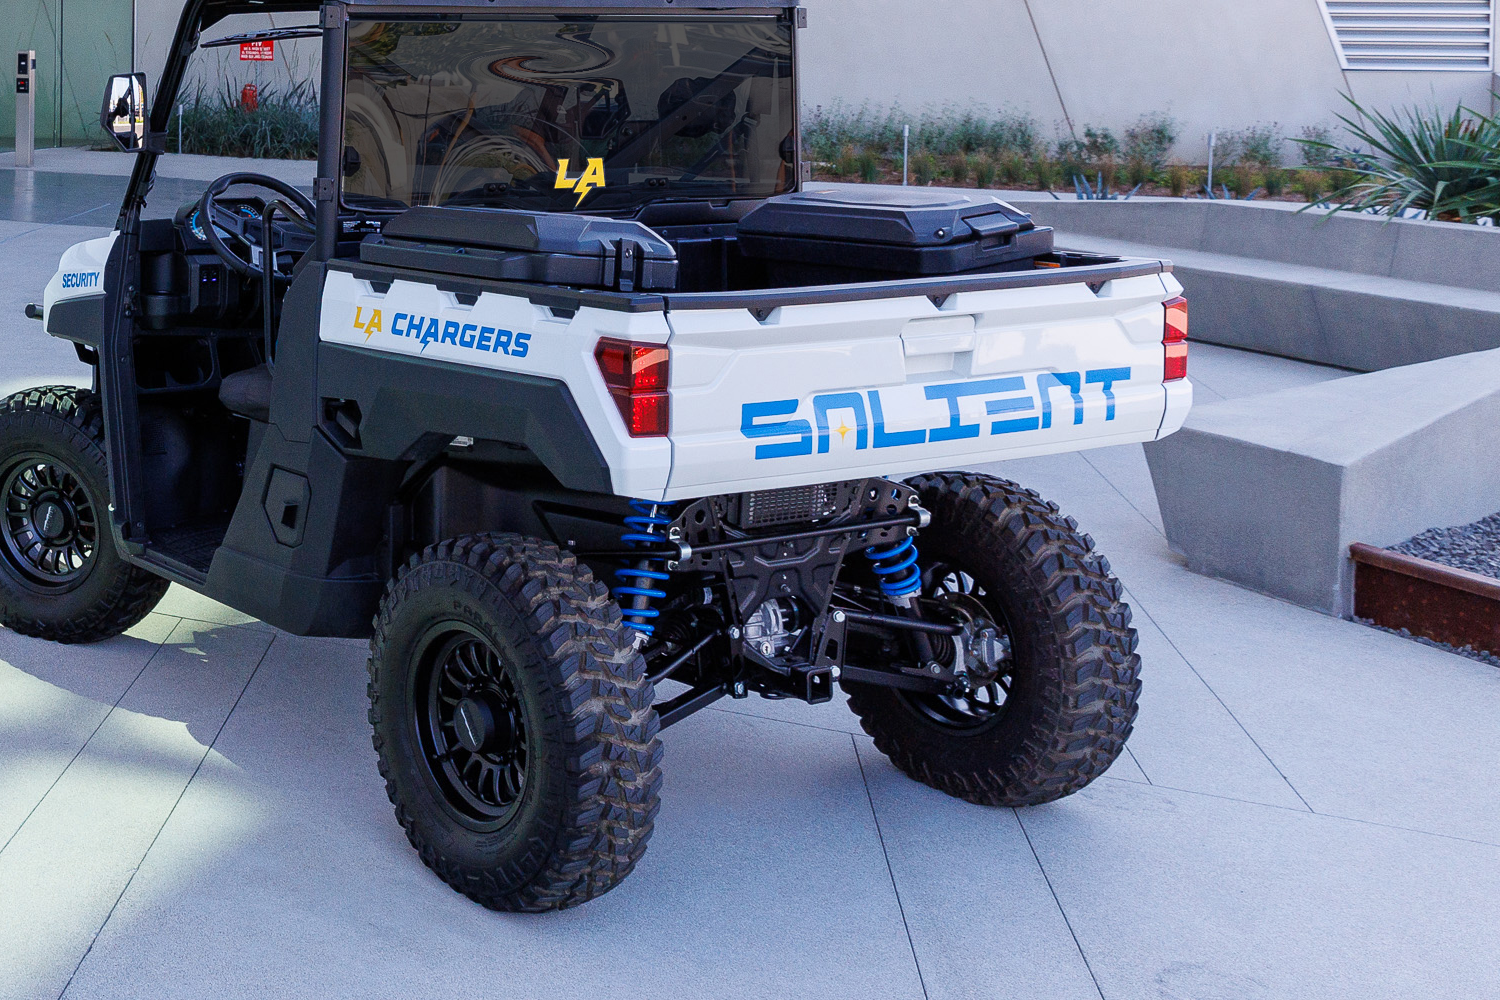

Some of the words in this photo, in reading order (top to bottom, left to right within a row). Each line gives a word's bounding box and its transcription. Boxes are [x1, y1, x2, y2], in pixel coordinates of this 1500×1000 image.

[554, 158, 607, 208] LA
[62, 272, 100, 288] SECURITY
[353, 306, 382, 344] LA
[391, 312, 532, 358] CHARGERS
[741, 367, 1131, 460] SALIENT
